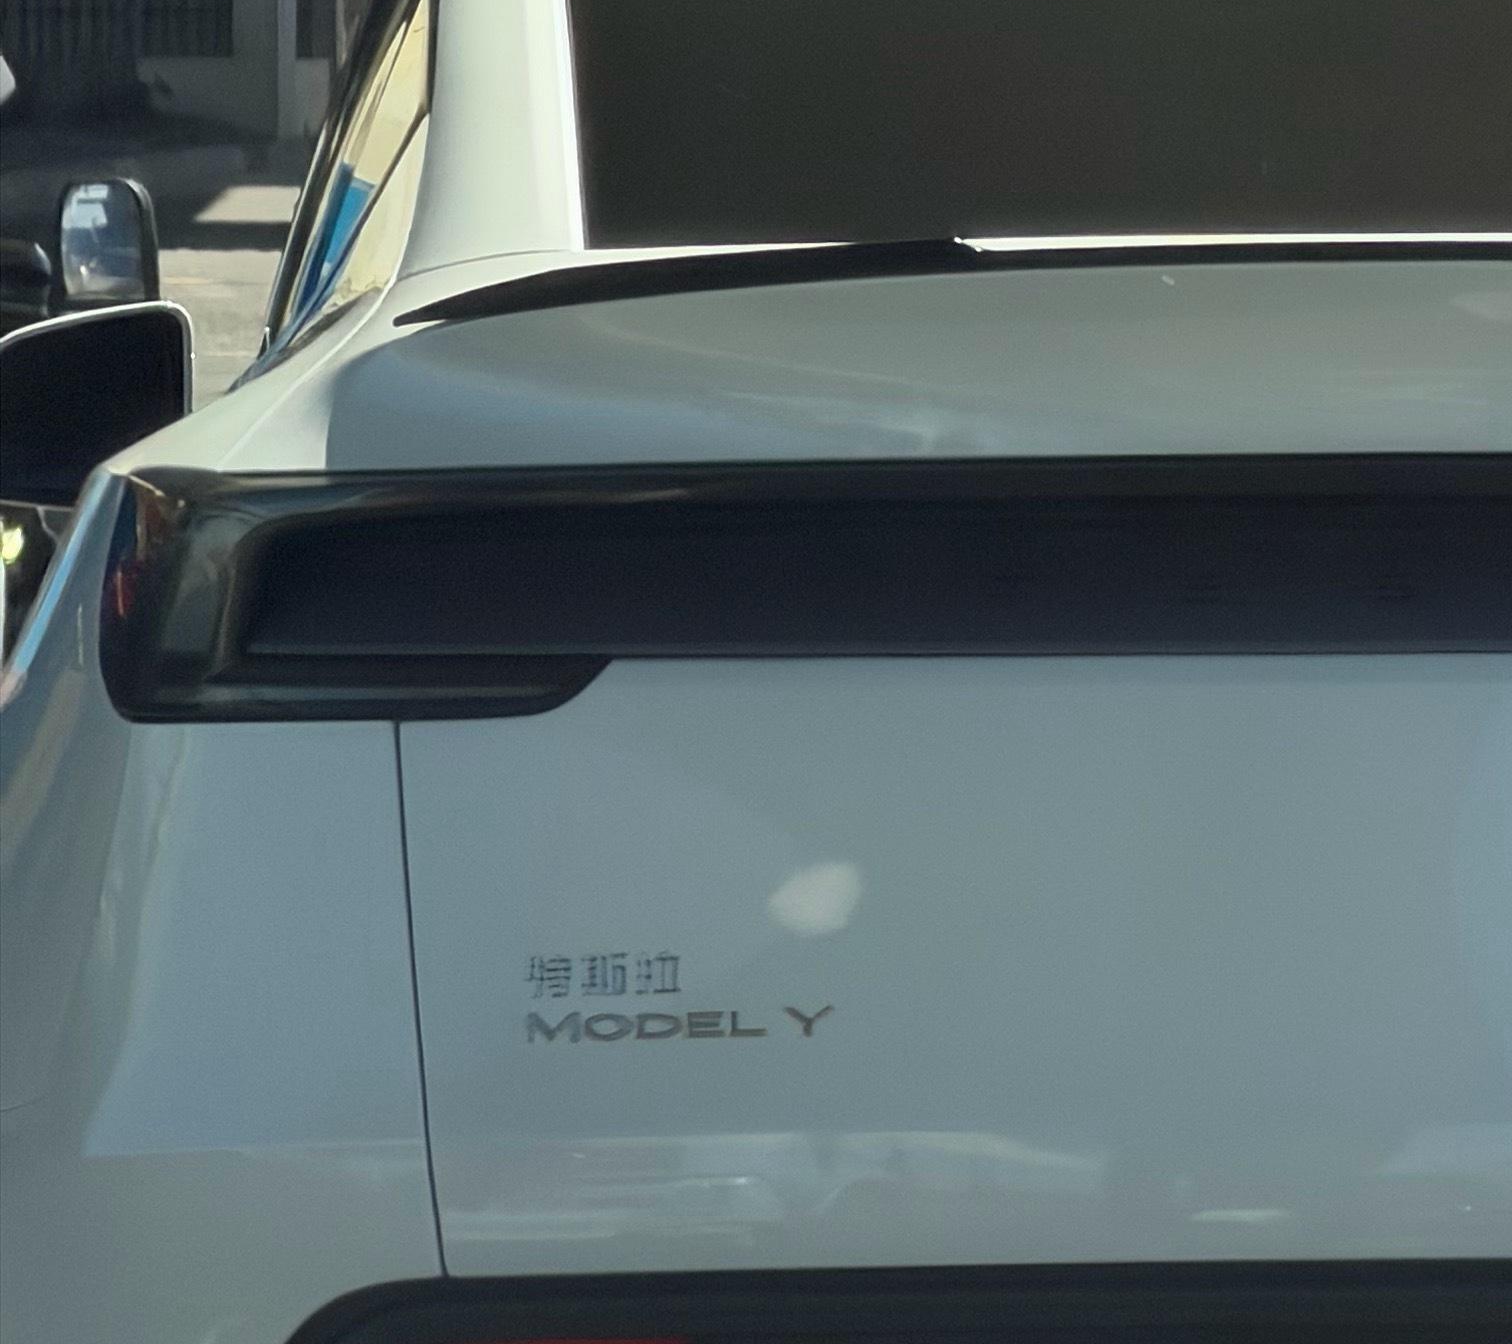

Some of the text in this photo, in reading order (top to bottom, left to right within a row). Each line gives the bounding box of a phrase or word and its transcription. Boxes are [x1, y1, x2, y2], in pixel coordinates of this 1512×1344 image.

[524, 951, 681, 999] 特斯拉
[526, 1004, 834, 1044] MODEL Y
